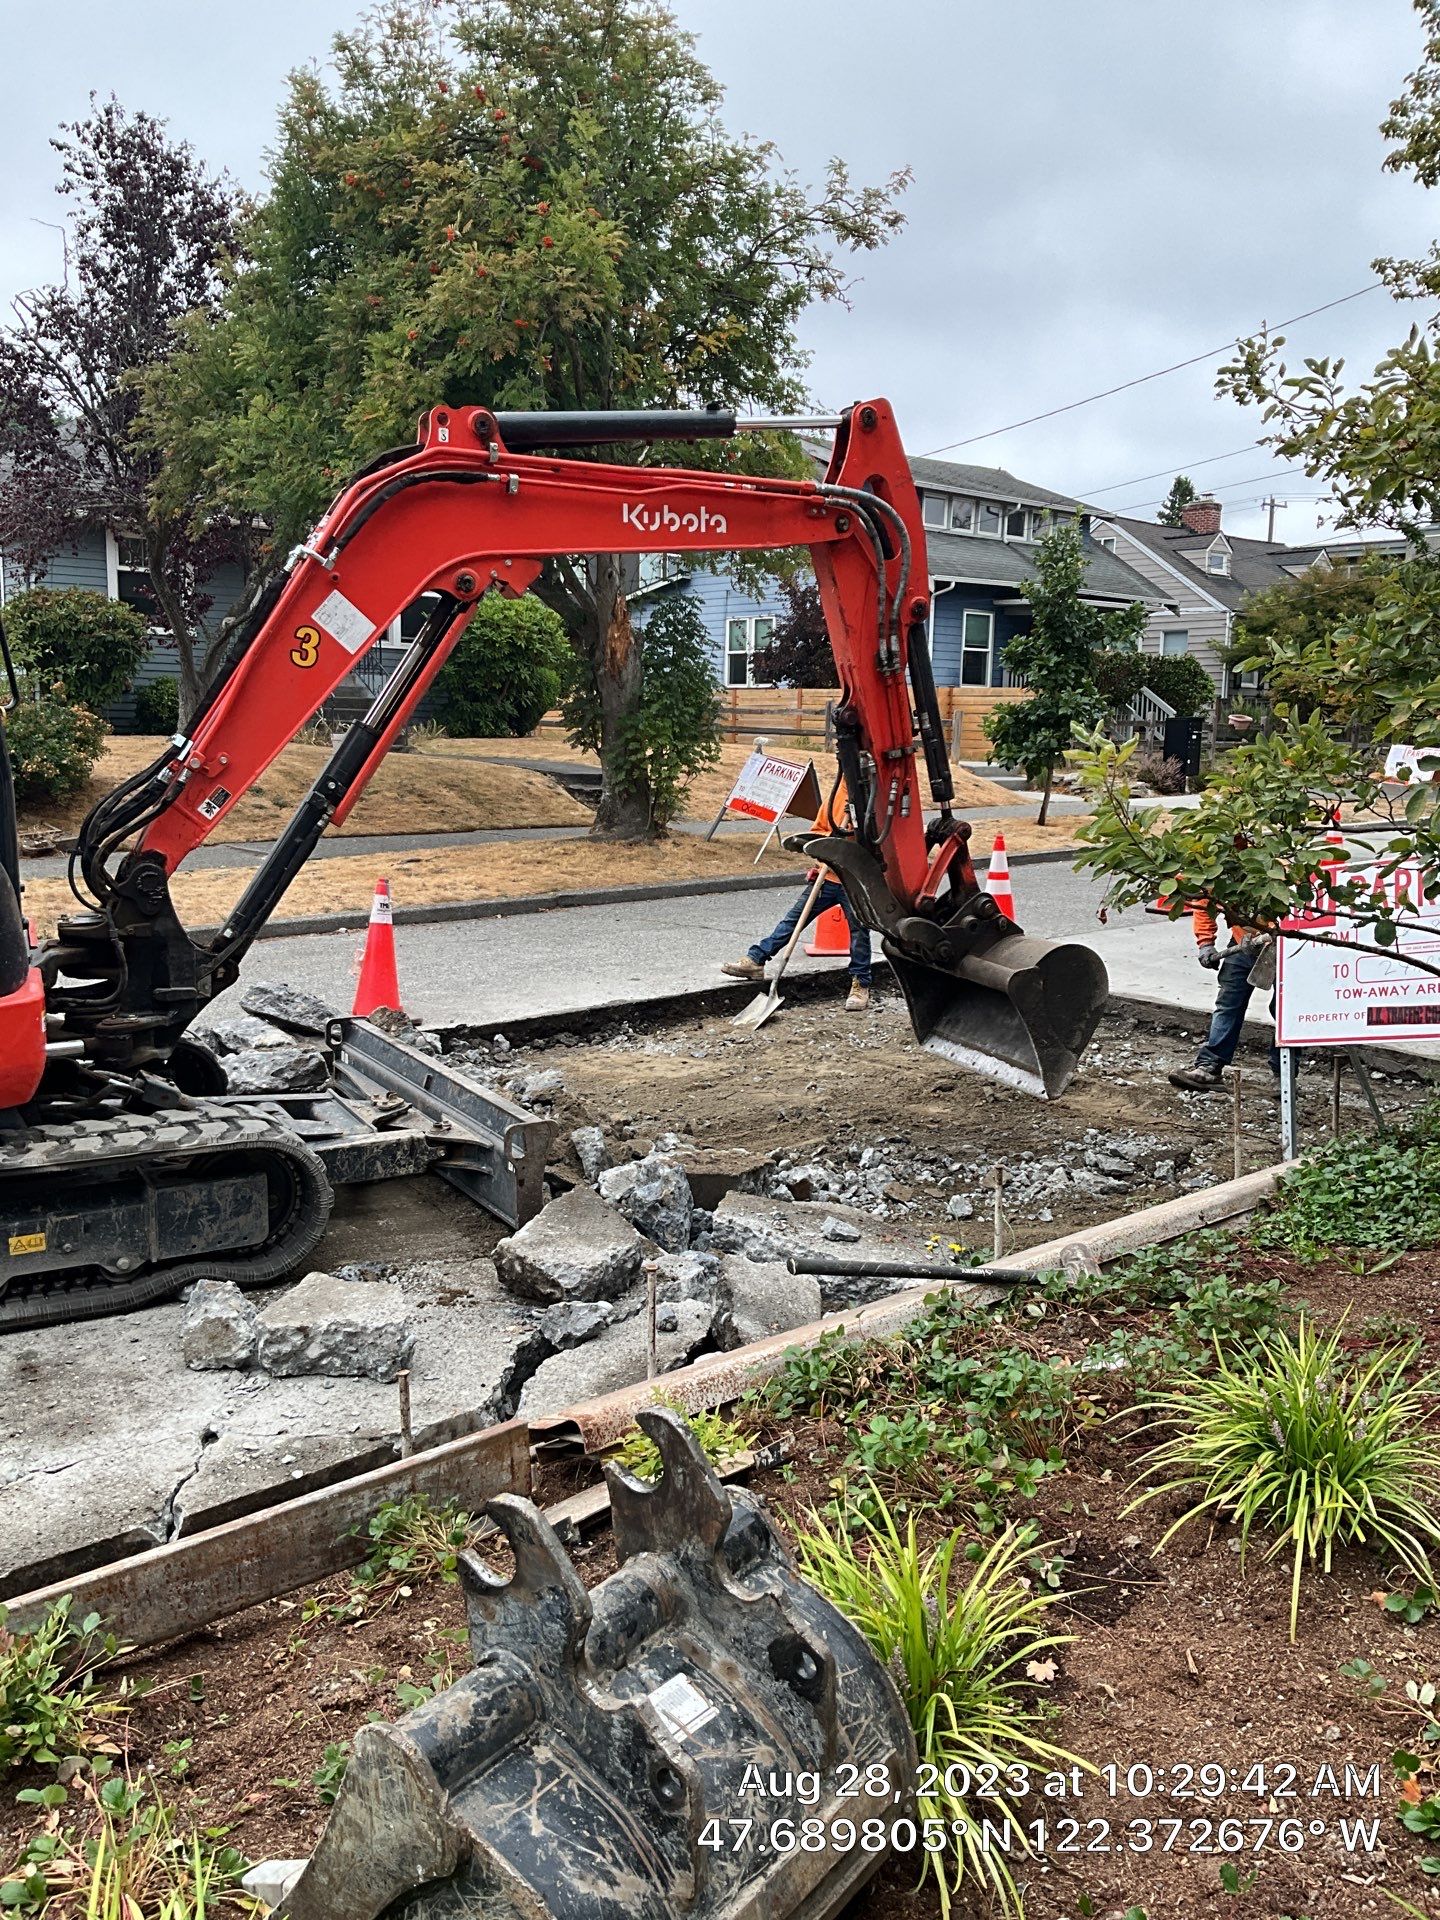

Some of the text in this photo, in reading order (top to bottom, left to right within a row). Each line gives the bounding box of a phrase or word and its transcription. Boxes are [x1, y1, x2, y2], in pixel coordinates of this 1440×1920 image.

[622, 503, 727, 533] Kubota
[290, 625, 321, 668] 3
[764, 762, 801, 783] PARKING
[1333, 963, 1350, 979] TO
[1334, 983, 1440, 1000] TOW-AWAY AR
[1298, 1012, 1350, 1022] PROPERTY
[1354, 1011, 1367, 1020] OF
